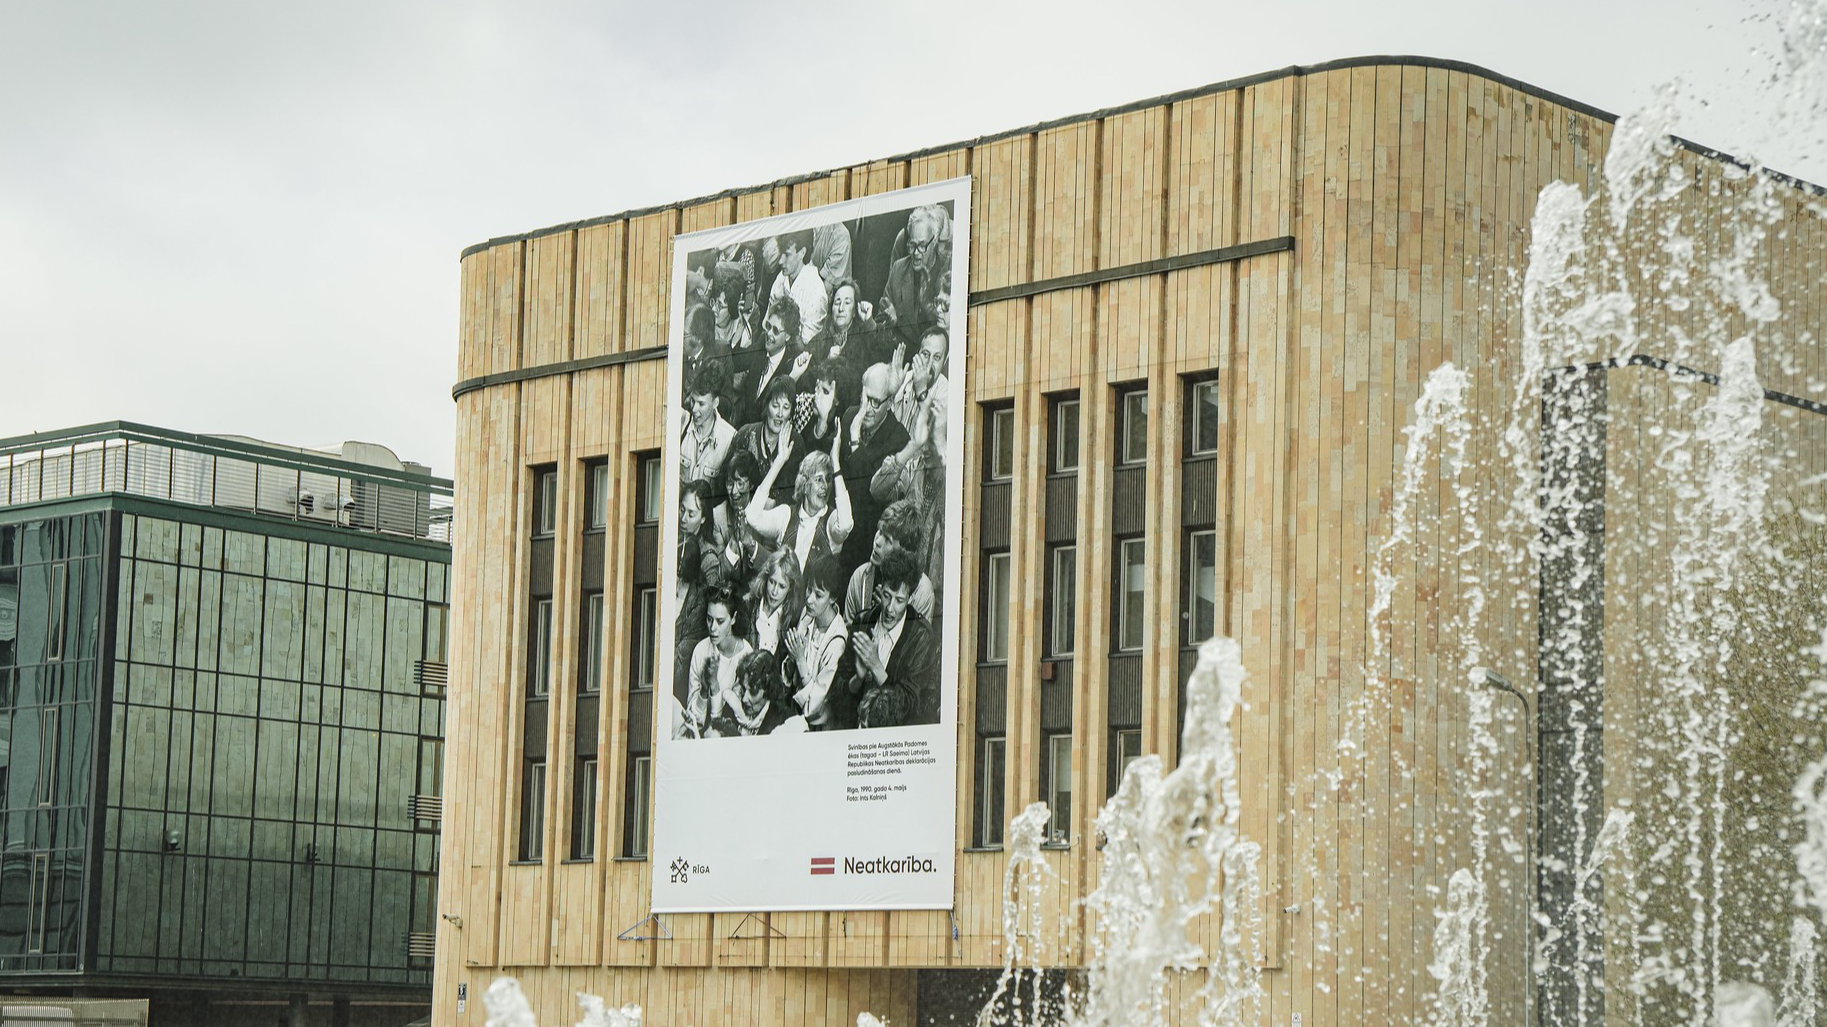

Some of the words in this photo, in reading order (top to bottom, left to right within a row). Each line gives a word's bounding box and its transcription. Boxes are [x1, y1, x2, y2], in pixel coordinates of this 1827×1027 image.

[878, 742, 903, 750] Augstākās
[890, 749, 910, 757] Saeima)
[847, 768, 886, 777] pasludināšanas
[847, 786, 859, 794] Rīga,
[874, 785, 887, 793] gada
[894, 784, 907, 792] maijs
[870, 794, 887, 802] Kalniņš
[692, 864, 710, 874] RĪGA
[844, 856, 937, 874] Neatkarība.
